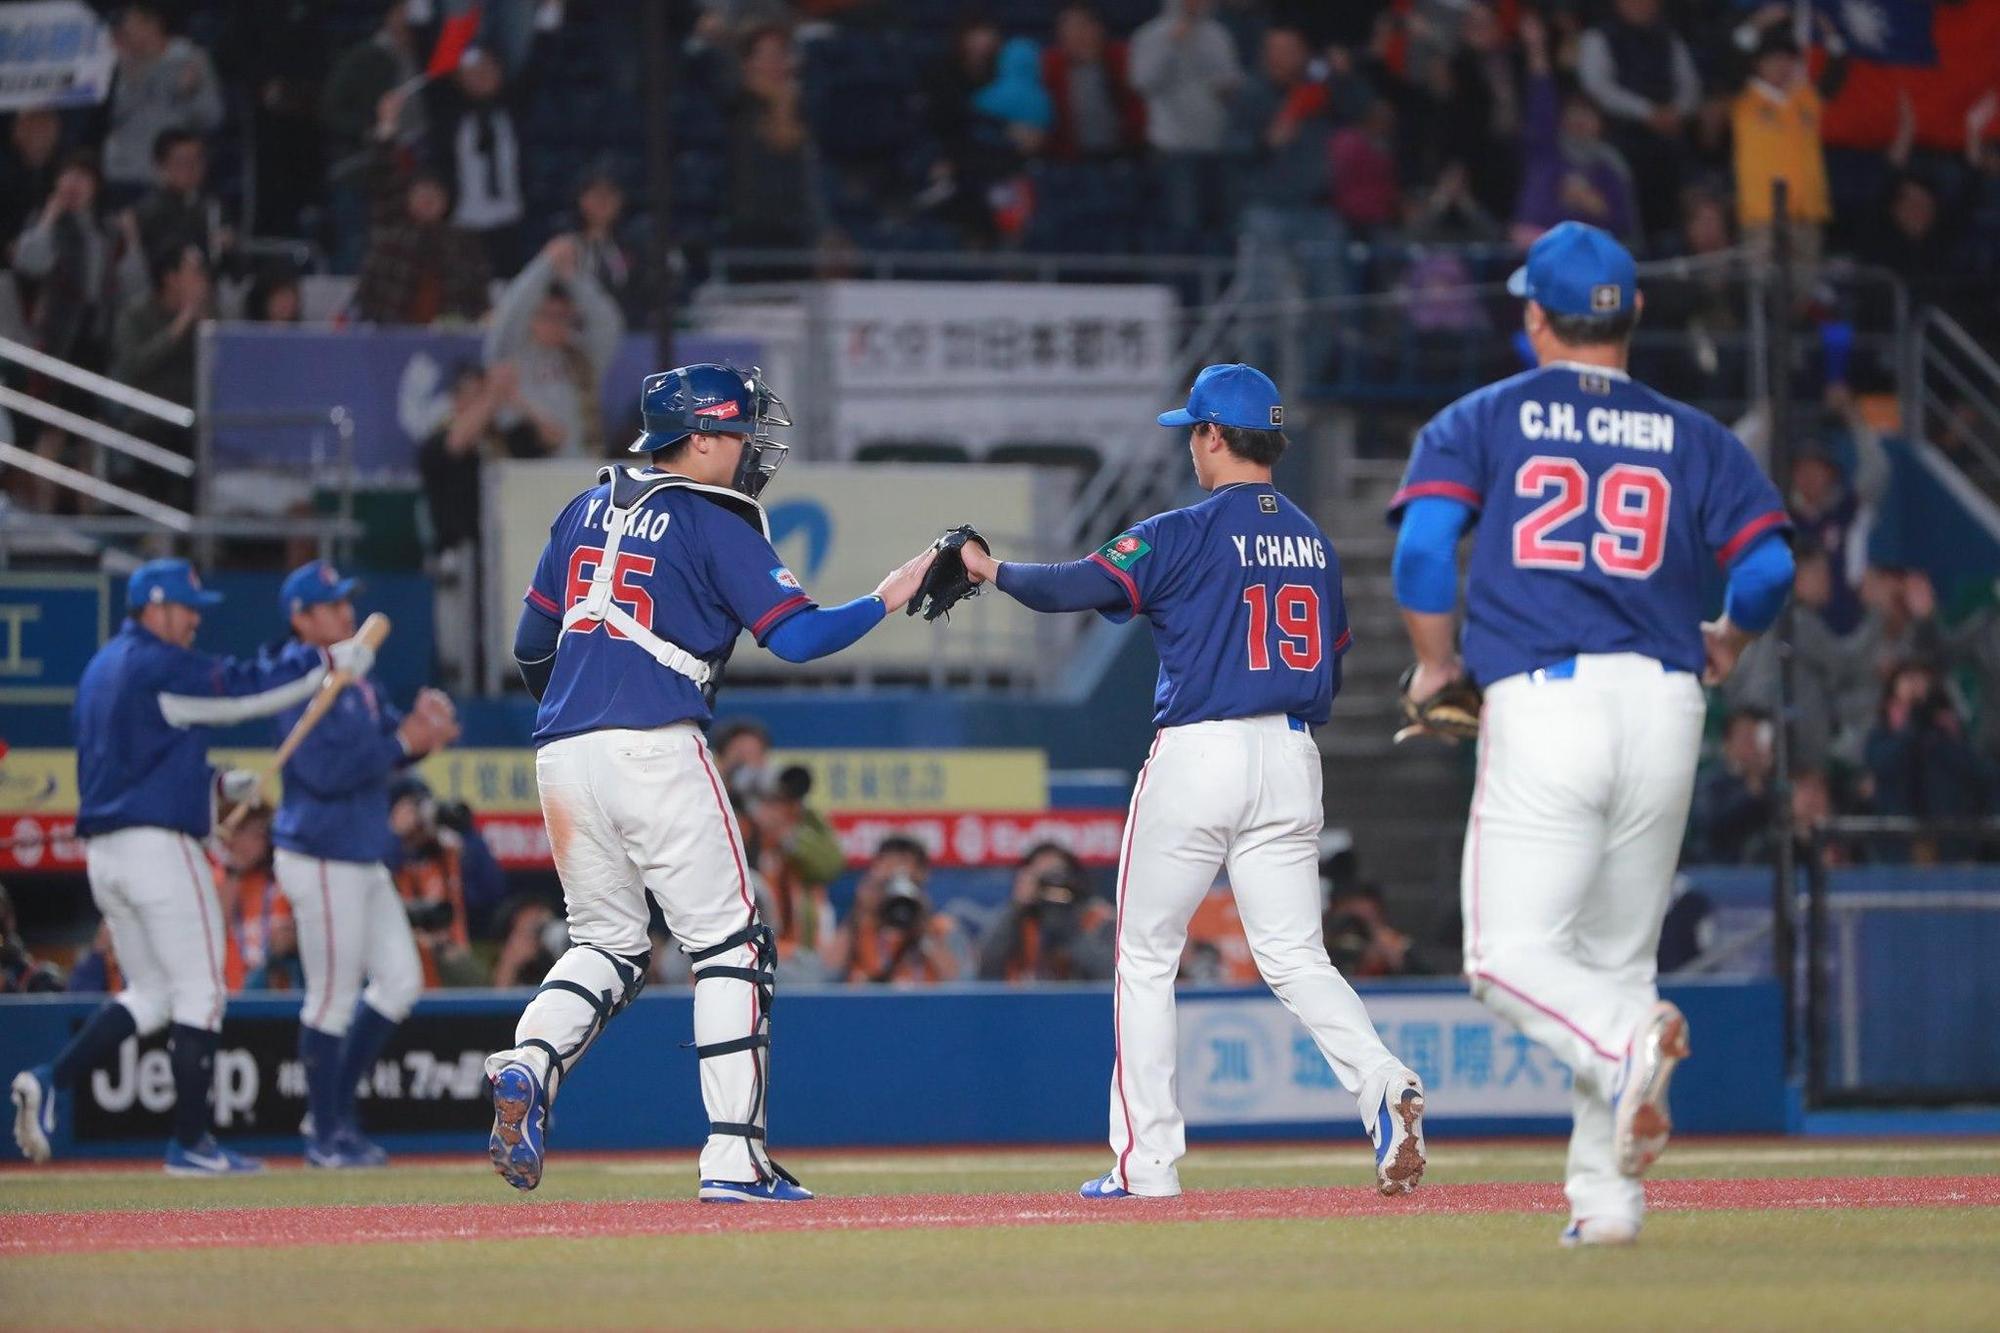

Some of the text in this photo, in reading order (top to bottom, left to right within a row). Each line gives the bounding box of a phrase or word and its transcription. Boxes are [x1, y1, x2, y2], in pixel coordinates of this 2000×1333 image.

[1520, 400, 1674, 454] C.H. CHEN
[622, 507, 670, 542] KAO
[1256, 535, 1326, 569] CHANG
[1513, 455, 1672, 580] 29
[565, 545, 656, 640] 65
[1243, 583, 1322, 672] 19
[91, 1036, 260, 1128] Jep
